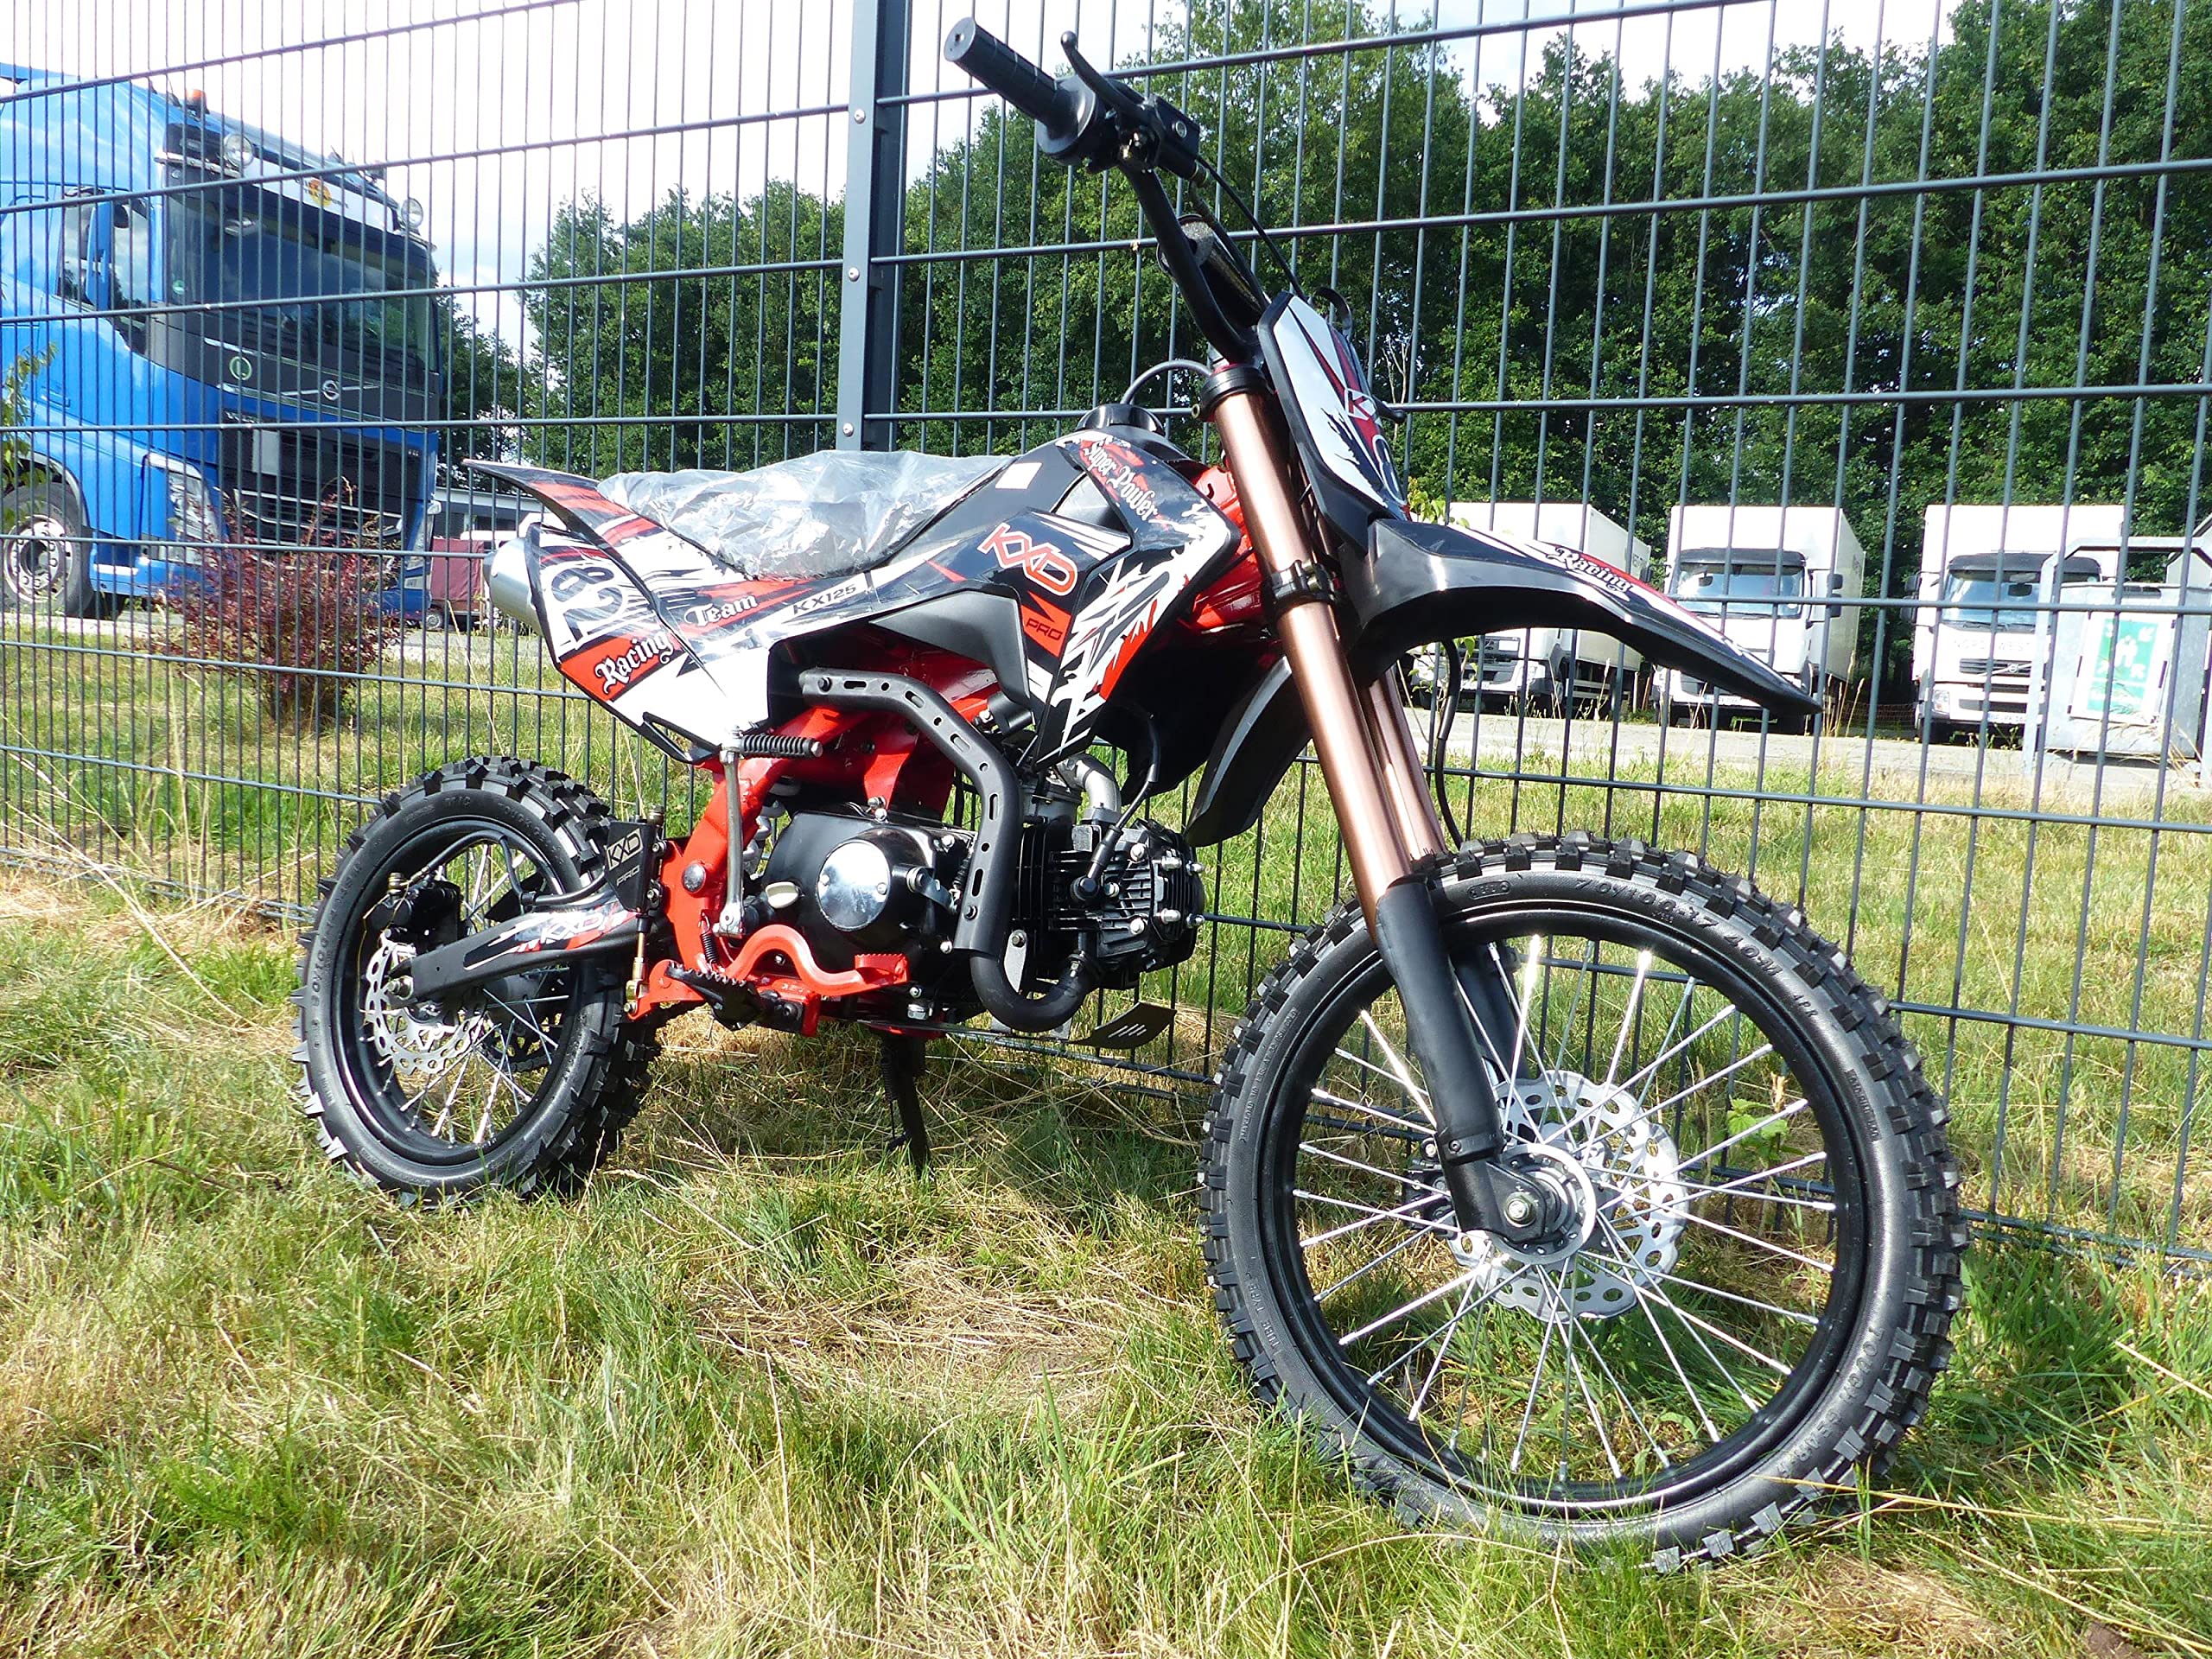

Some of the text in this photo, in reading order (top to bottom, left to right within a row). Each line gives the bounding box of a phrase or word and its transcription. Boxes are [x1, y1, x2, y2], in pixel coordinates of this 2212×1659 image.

[1083, 439, 1158, 521] Super Power
[976, 522, 1077, 596] KXD
[1545, 546, 1634, 594] Racing
[683, 594, 758, 626] Team
[792, 584, 856, 614] KX125
[1026, 617, 1064, 641] PRO
[594, 630, 674, 694] Racing
[607, 828, 643, 871] KXD
[616, 865, 640, 887] PRO
[540, 912, 605, 944] KXD
